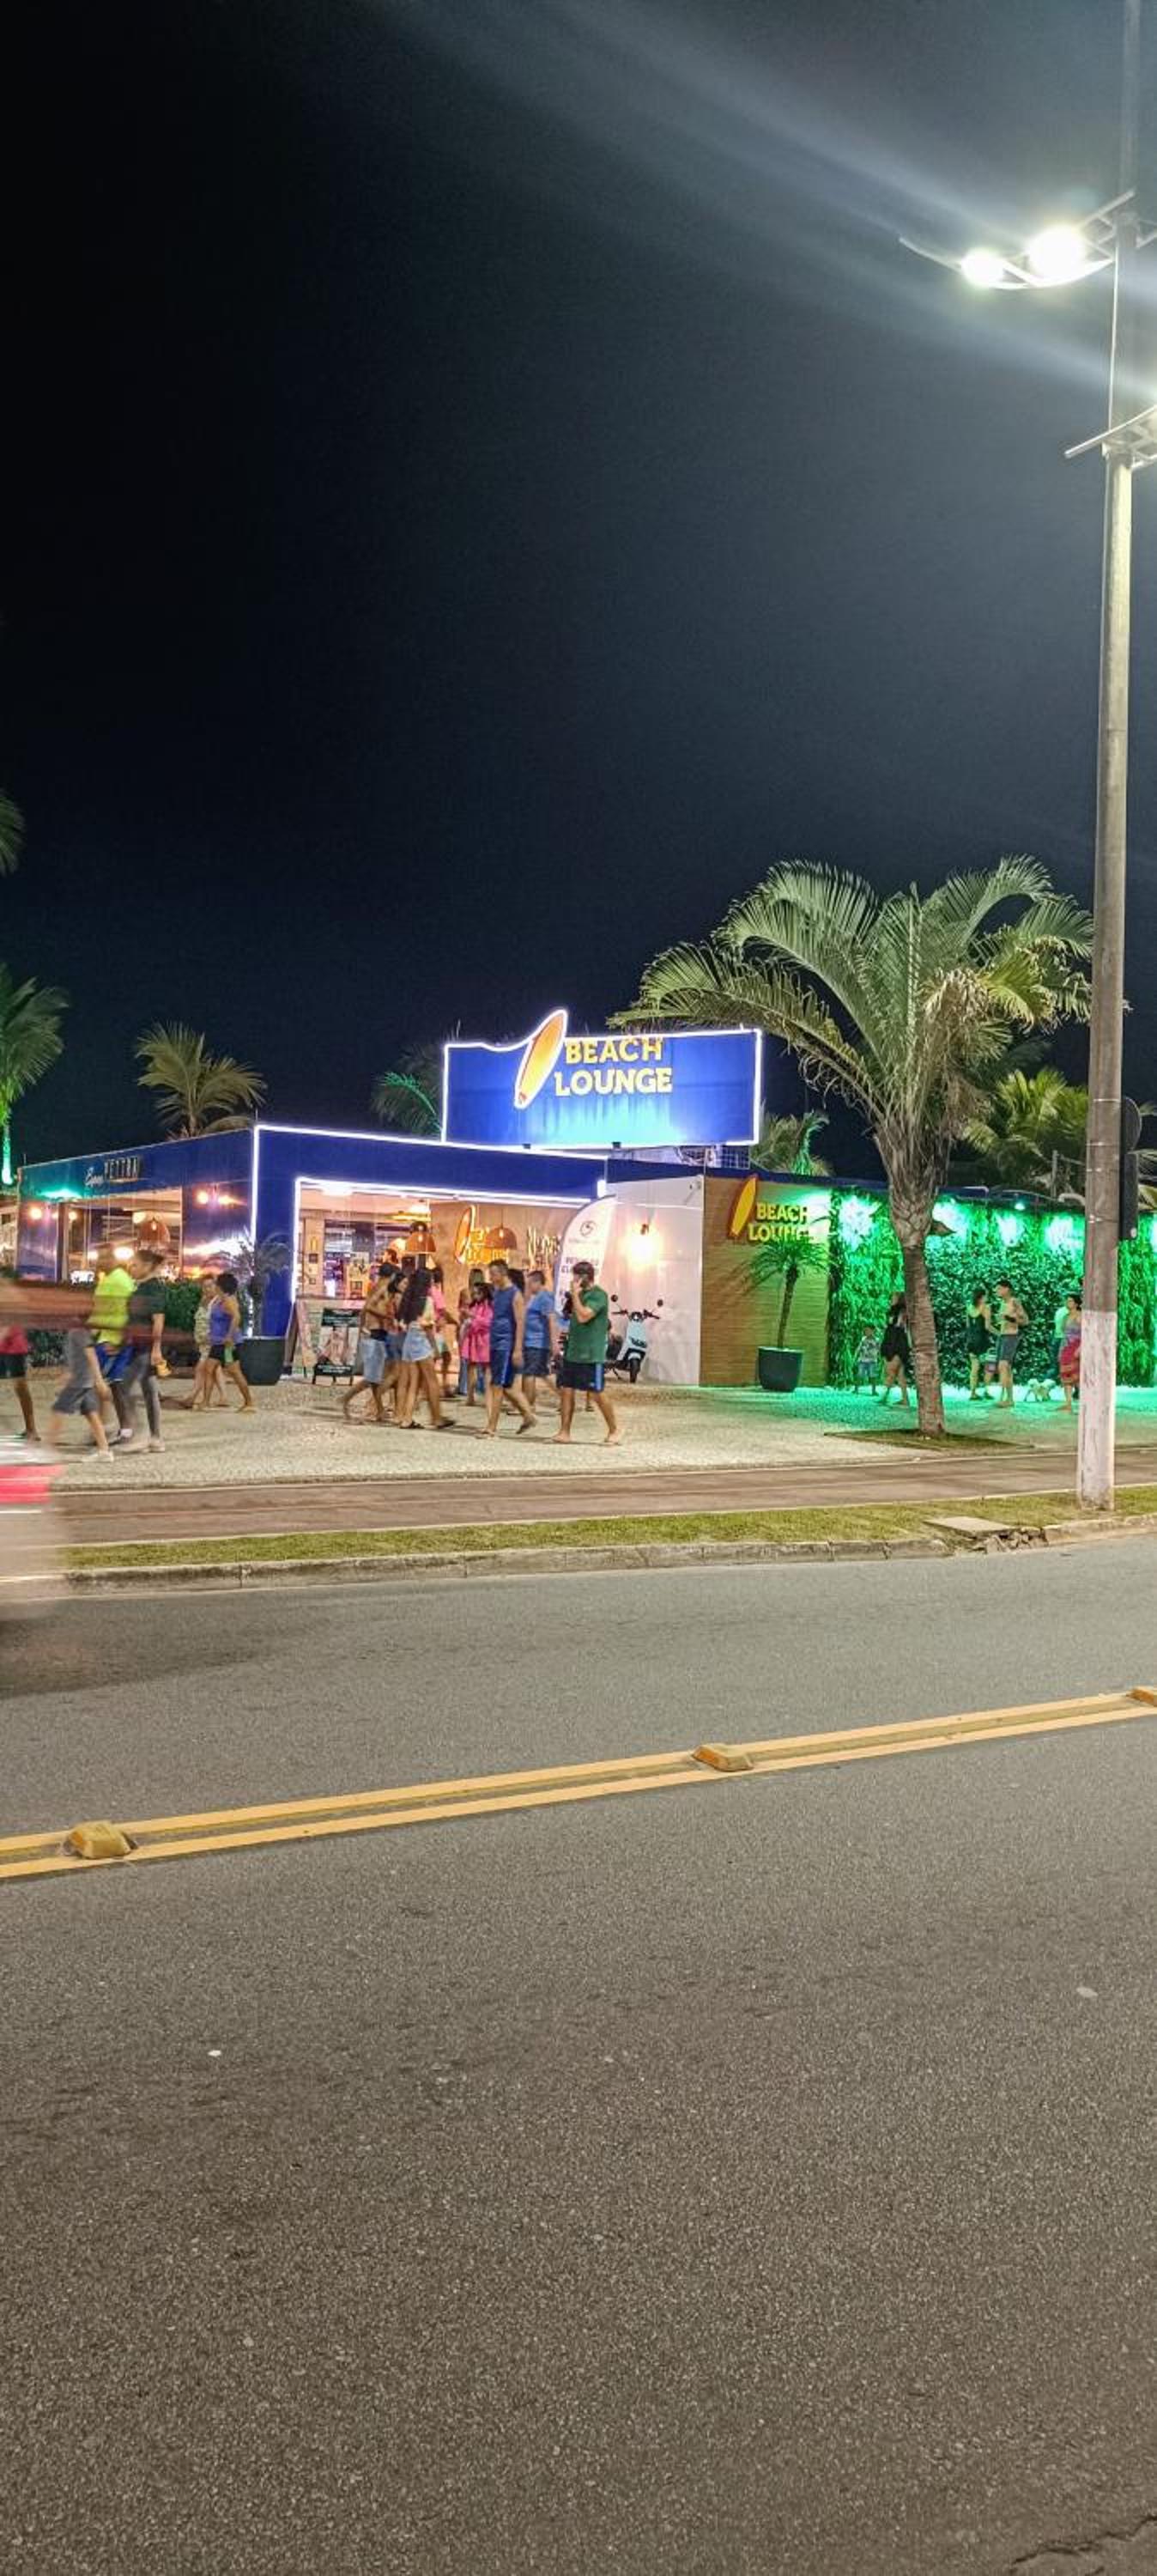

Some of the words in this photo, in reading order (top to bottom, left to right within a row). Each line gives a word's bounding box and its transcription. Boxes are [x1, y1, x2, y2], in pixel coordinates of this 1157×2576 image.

[564, 1036, 663, 1064] BEACH
[554, 1067, 673, 1097] LOUNGE
[755, 1202, 811, 1222] BEACH
